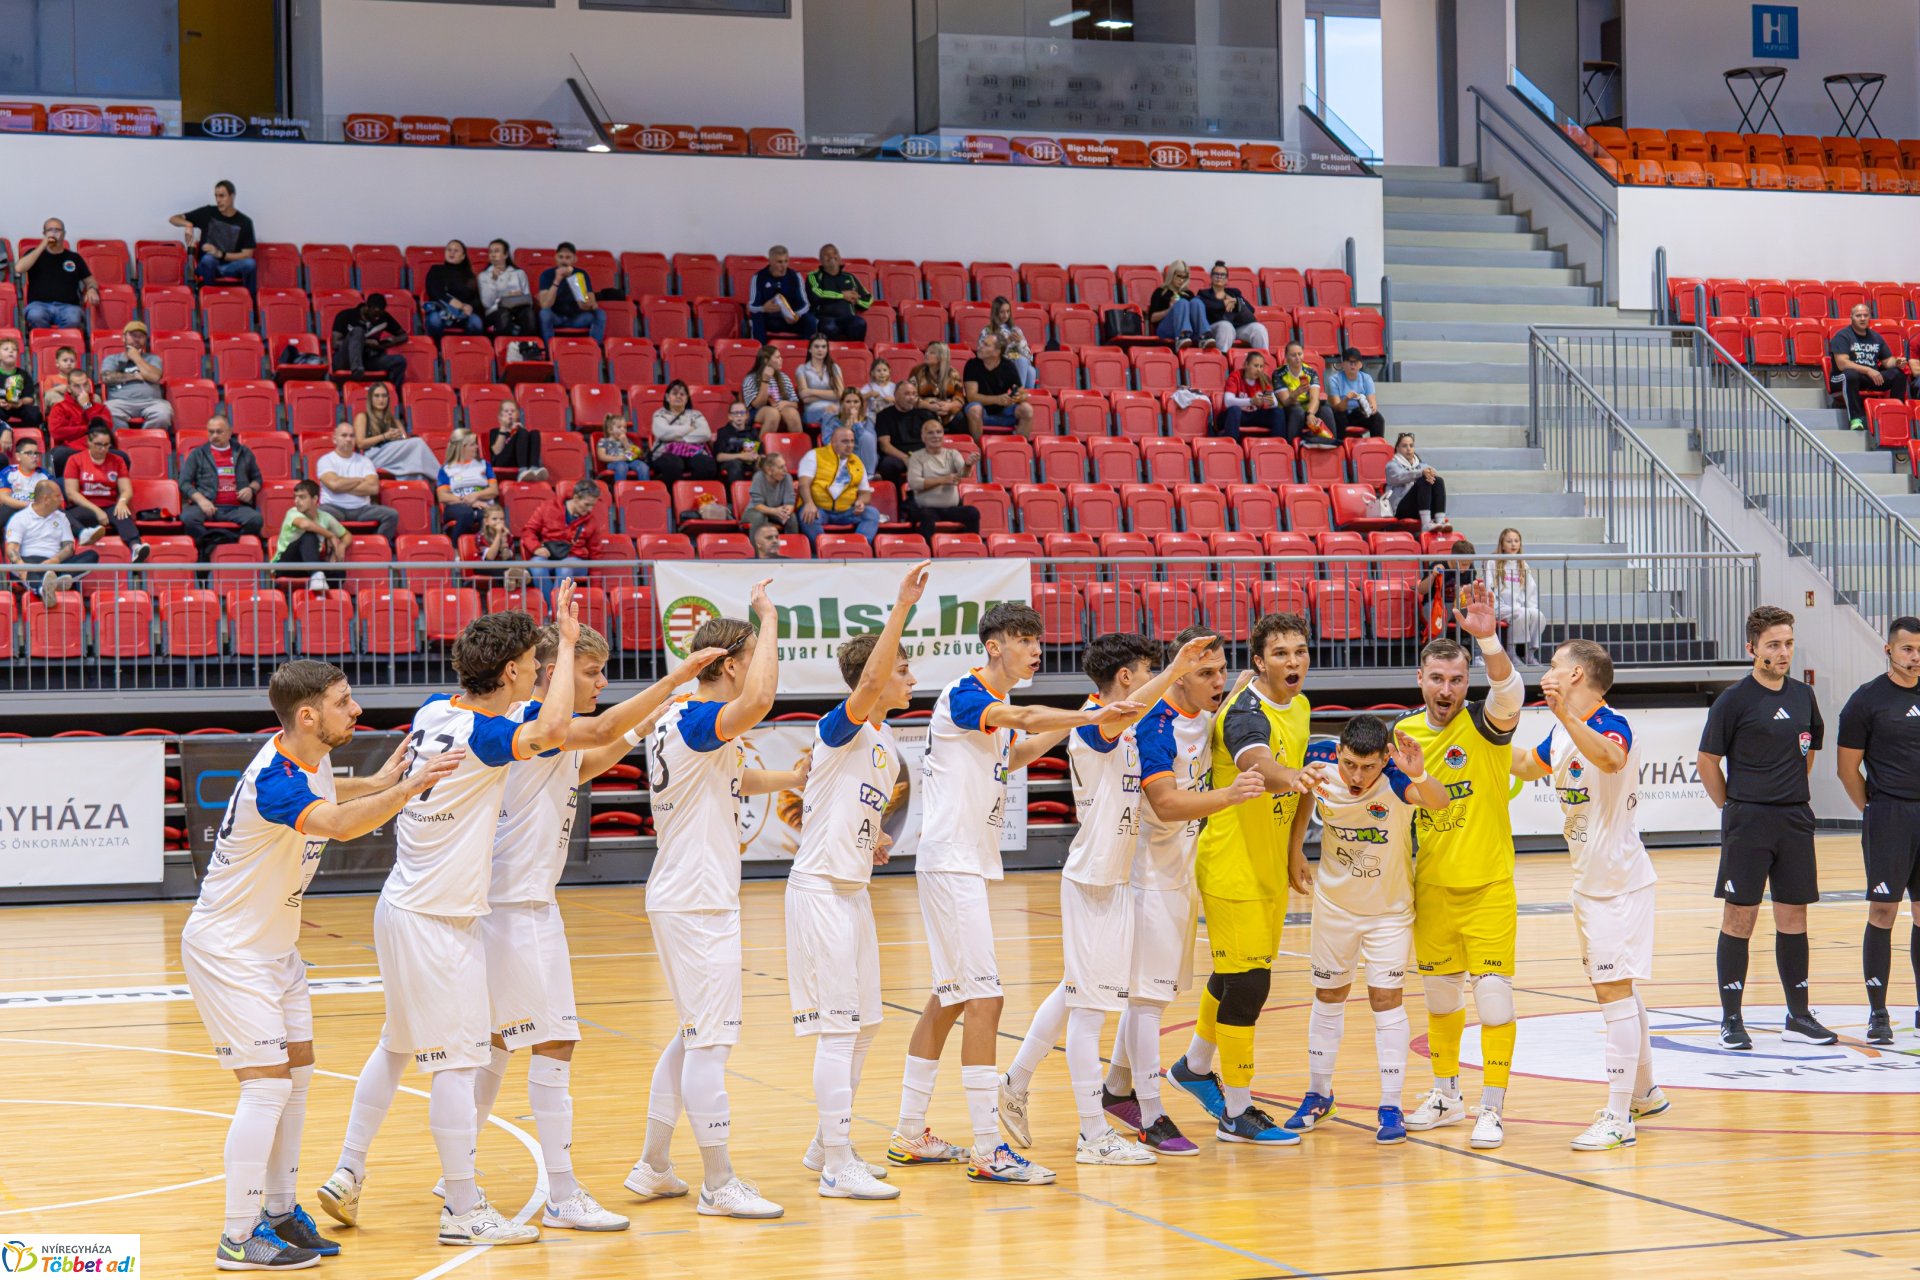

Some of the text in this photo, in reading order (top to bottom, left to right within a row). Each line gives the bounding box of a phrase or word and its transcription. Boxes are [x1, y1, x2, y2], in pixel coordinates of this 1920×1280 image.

[1200, 158, 1232, 167] Csoport
[12, 837, 129, 850] ÖNKORMÁNYZATA
[1483, 958, 1502, 967] JAKO
[520, 1022, 536, 1033] FM
[431, 1051, 447, 1061] FM
